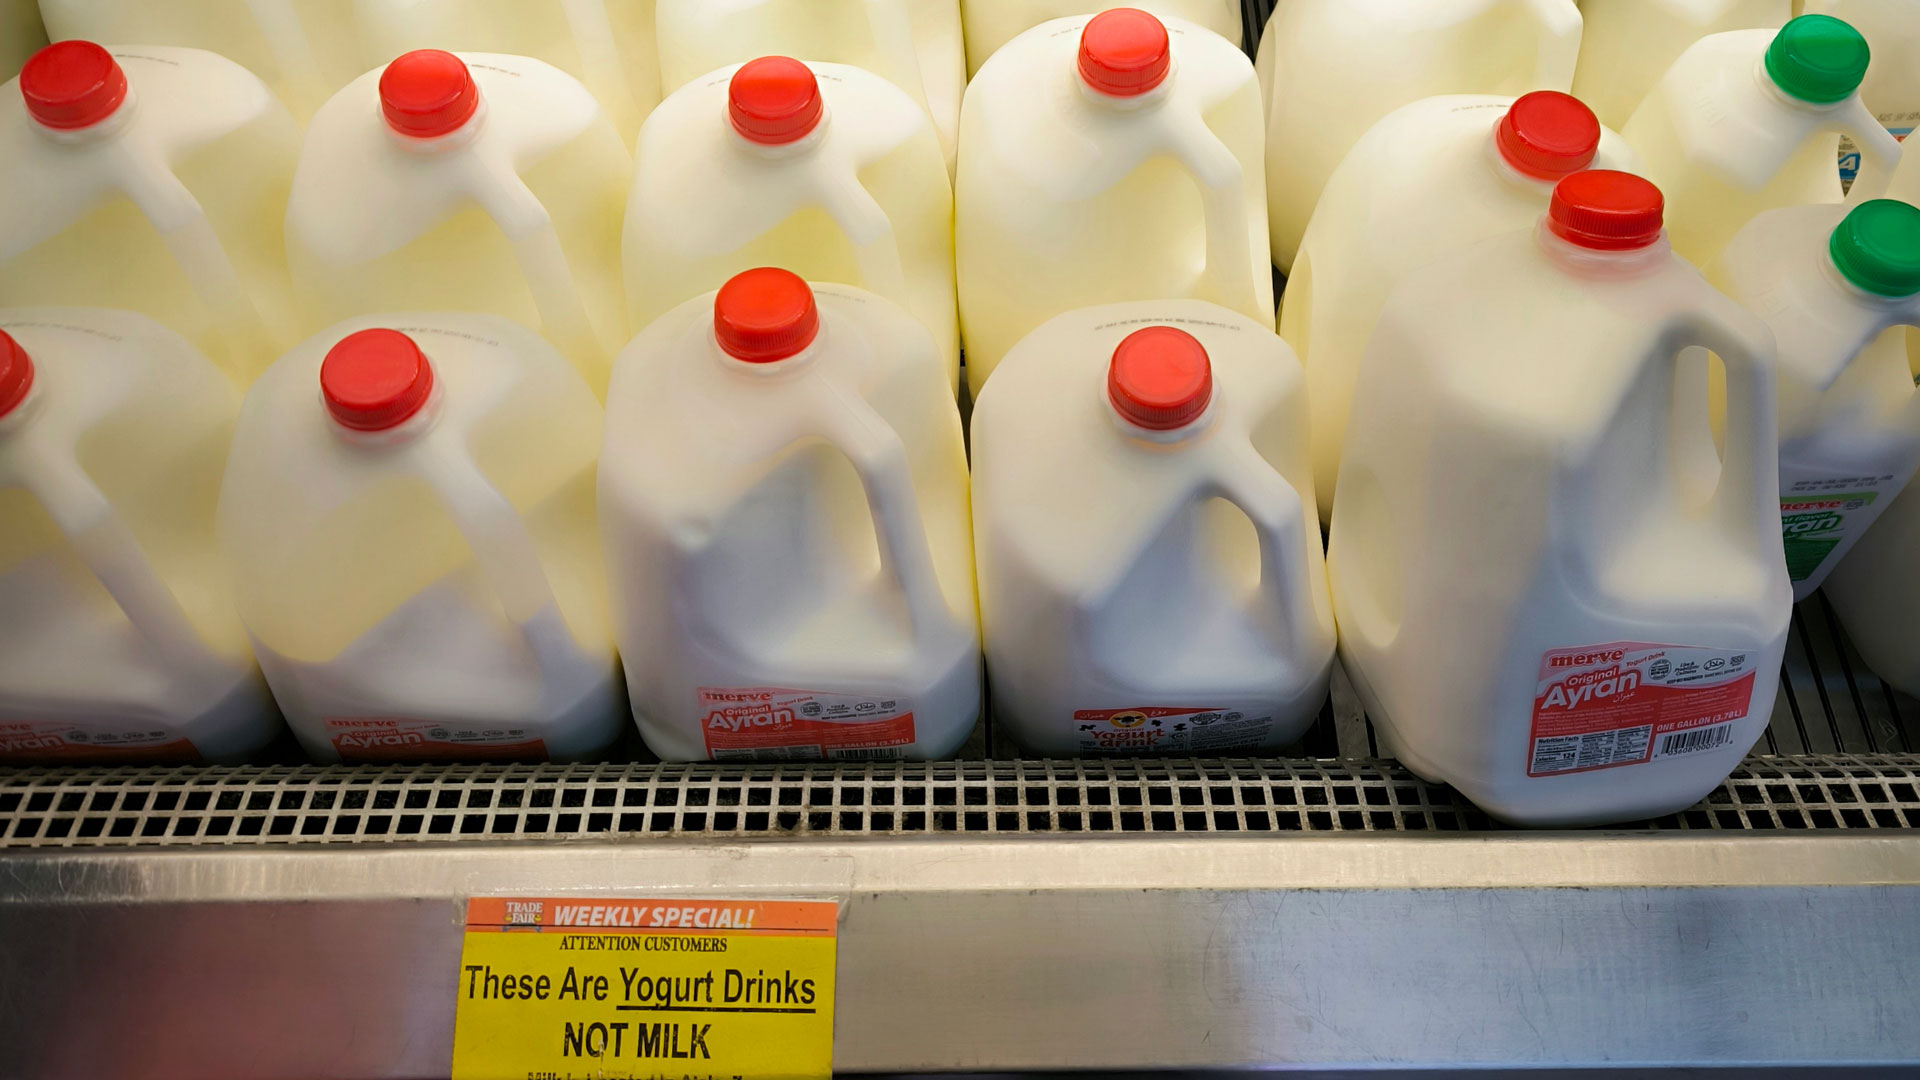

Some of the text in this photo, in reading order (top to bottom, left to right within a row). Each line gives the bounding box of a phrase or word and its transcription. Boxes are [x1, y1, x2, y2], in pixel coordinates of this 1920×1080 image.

[1782, 517, 1838, 533] ran
[1549, 649, 1624, 668] merve
[1568, 667, 1617, 687] Original
[704, 692, 771, 702] merve
[1540, 672, 1637, 710] Ayran
[726, 705, 770, 716] Original
[708, 708, 792, 732] Ayran
[1656, 722, 1676, 732] ONE
[1677, 716, 1711, 729] GALLON
[339, 732, 421, 748] Ayran
[1090, 728, 1165, 740] Yogurt
[1099, 737, 1160, 747] drink
[0, 735, 59, 751] yran
[506, 902, 544, 913] TRADE
[512, 913, 535, 924] FAIR
[554, 905, 755, 928] WEEKLY SPECIAL!
[559, 936, 728, 953] ATTENTION CUSTOMERS
[465, 965, 816, 1007] These Are Yogurt Drinks
[562, 1021, 712, 1060] NOT MILK
